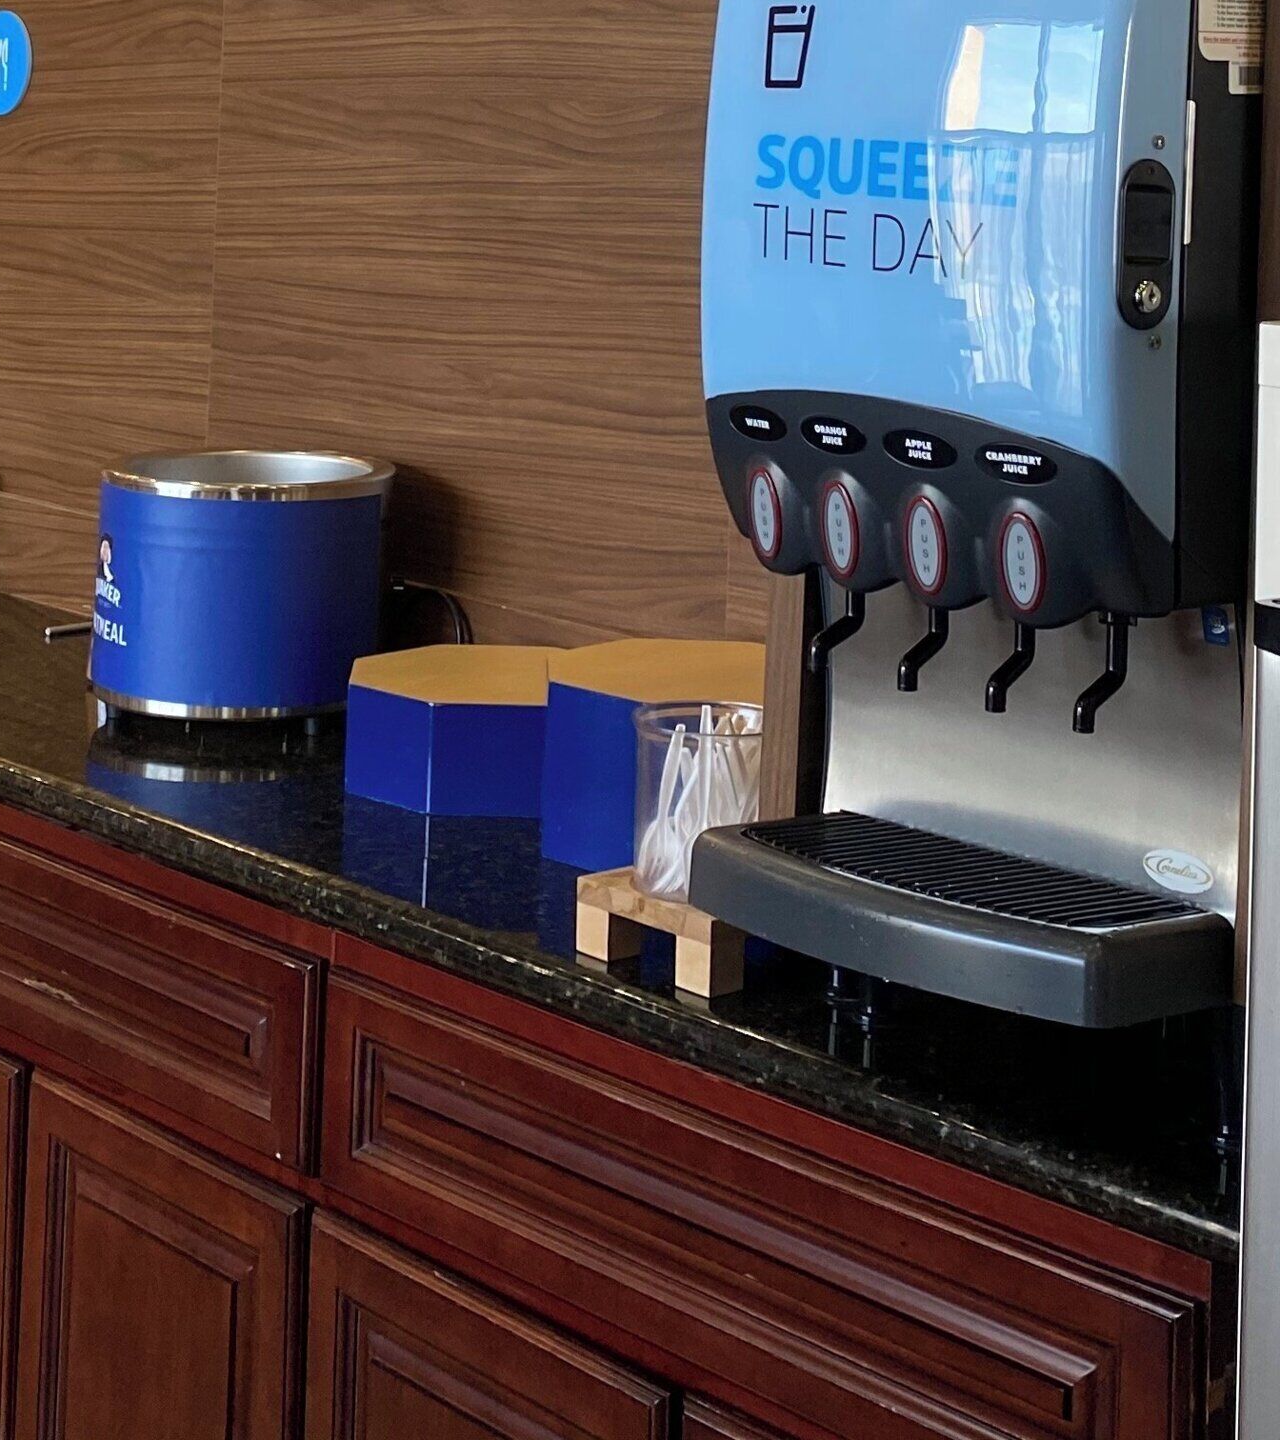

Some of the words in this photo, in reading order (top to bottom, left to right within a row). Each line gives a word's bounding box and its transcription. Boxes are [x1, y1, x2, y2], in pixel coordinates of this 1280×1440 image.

[753, 202, 847, 267] THE
[872, 213, 983, 279] DAY
[745, 417, 770, 430] WATER
[814, 424, 847, 437] ORANGE
[822, 435, 843, 446] JUICE
[905, 438, 932, 451] APPLE
[907, 449, 932, 461] JUICE
[985, 451, 1042, 466] CRANBERRY
[1002, 463, 1028, 475] JUICE
[834, 503, 844, 556] PUSH
[920, 518, 931, 573] PUSH
[1016, 535, 1027, 590] PUSH
